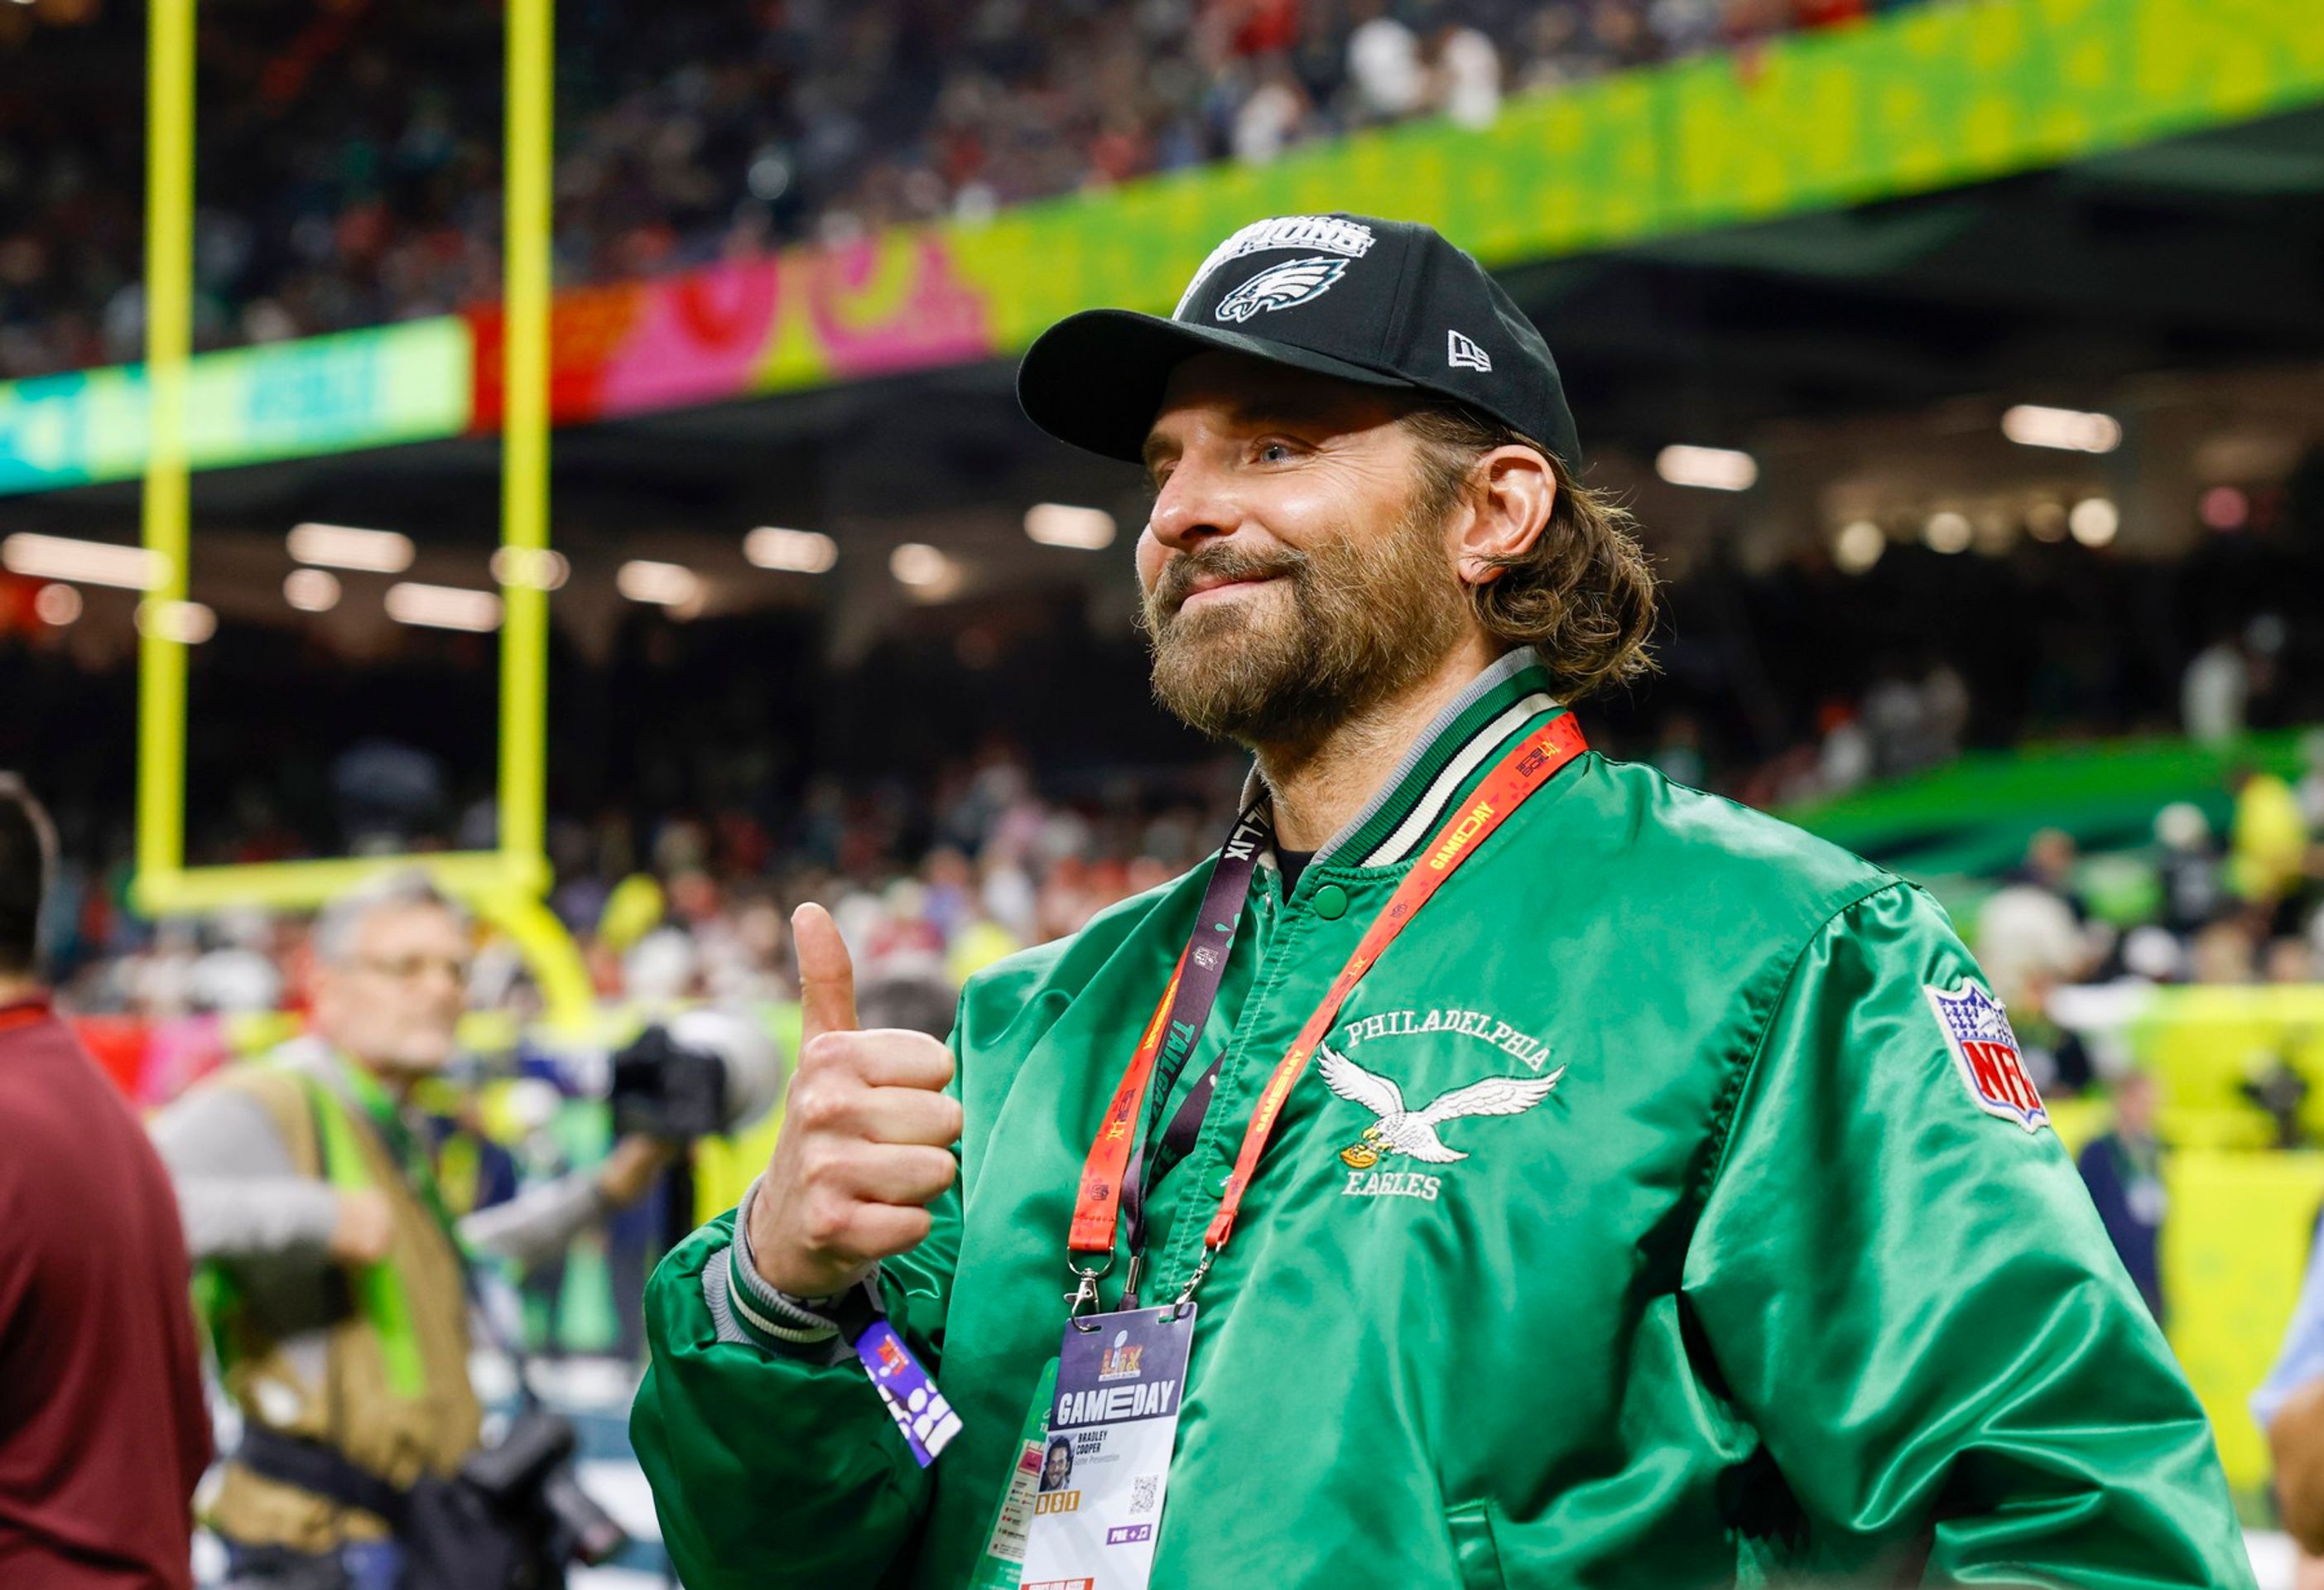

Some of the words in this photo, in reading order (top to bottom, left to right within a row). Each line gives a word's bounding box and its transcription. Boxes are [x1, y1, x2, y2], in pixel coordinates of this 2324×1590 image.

[1224, 824, 1263, 861] LIX
[1429, 800, 1495, 870] GAMEDAY
[1344, 1009, 1551, 1072] PHILADELPHIA
[1255, 1048, 1305, 1134] GAMEDAY
[1961, 1041, 2041, 1111] NFL
[1341, 1171, 1441, 1202] EAGLES
[1056, 1379, 1176, 1426] GAMEDAY
[1075, 1443, 1102, 1455] COOPER
[1078, 1430, 1108, 1443] BRADLEY
